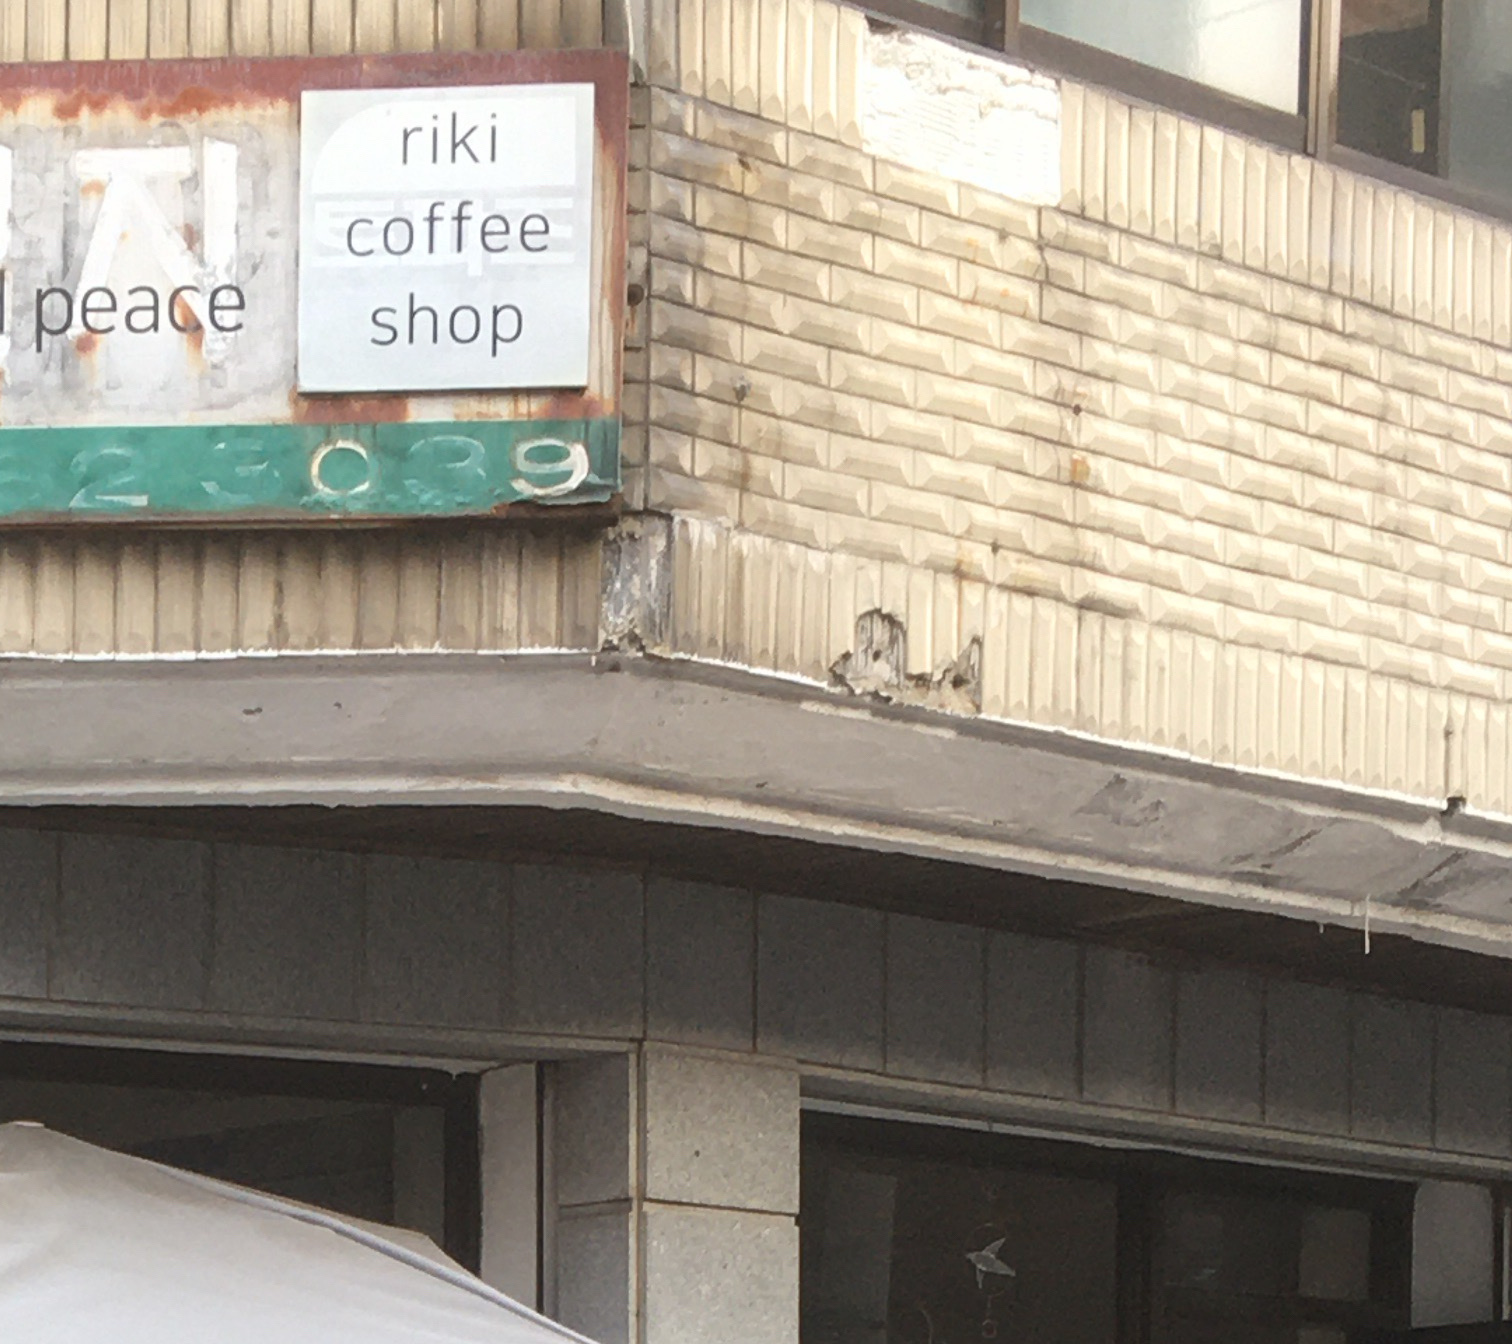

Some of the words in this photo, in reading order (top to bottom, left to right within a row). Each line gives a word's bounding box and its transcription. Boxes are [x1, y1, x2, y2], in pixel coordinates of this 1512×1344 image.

[401, 111, 498, 165] riki
[346, 199, 551, 257] coffee
[34, 280, 249, 354] peace
[370, 292, 524, 358] shop
